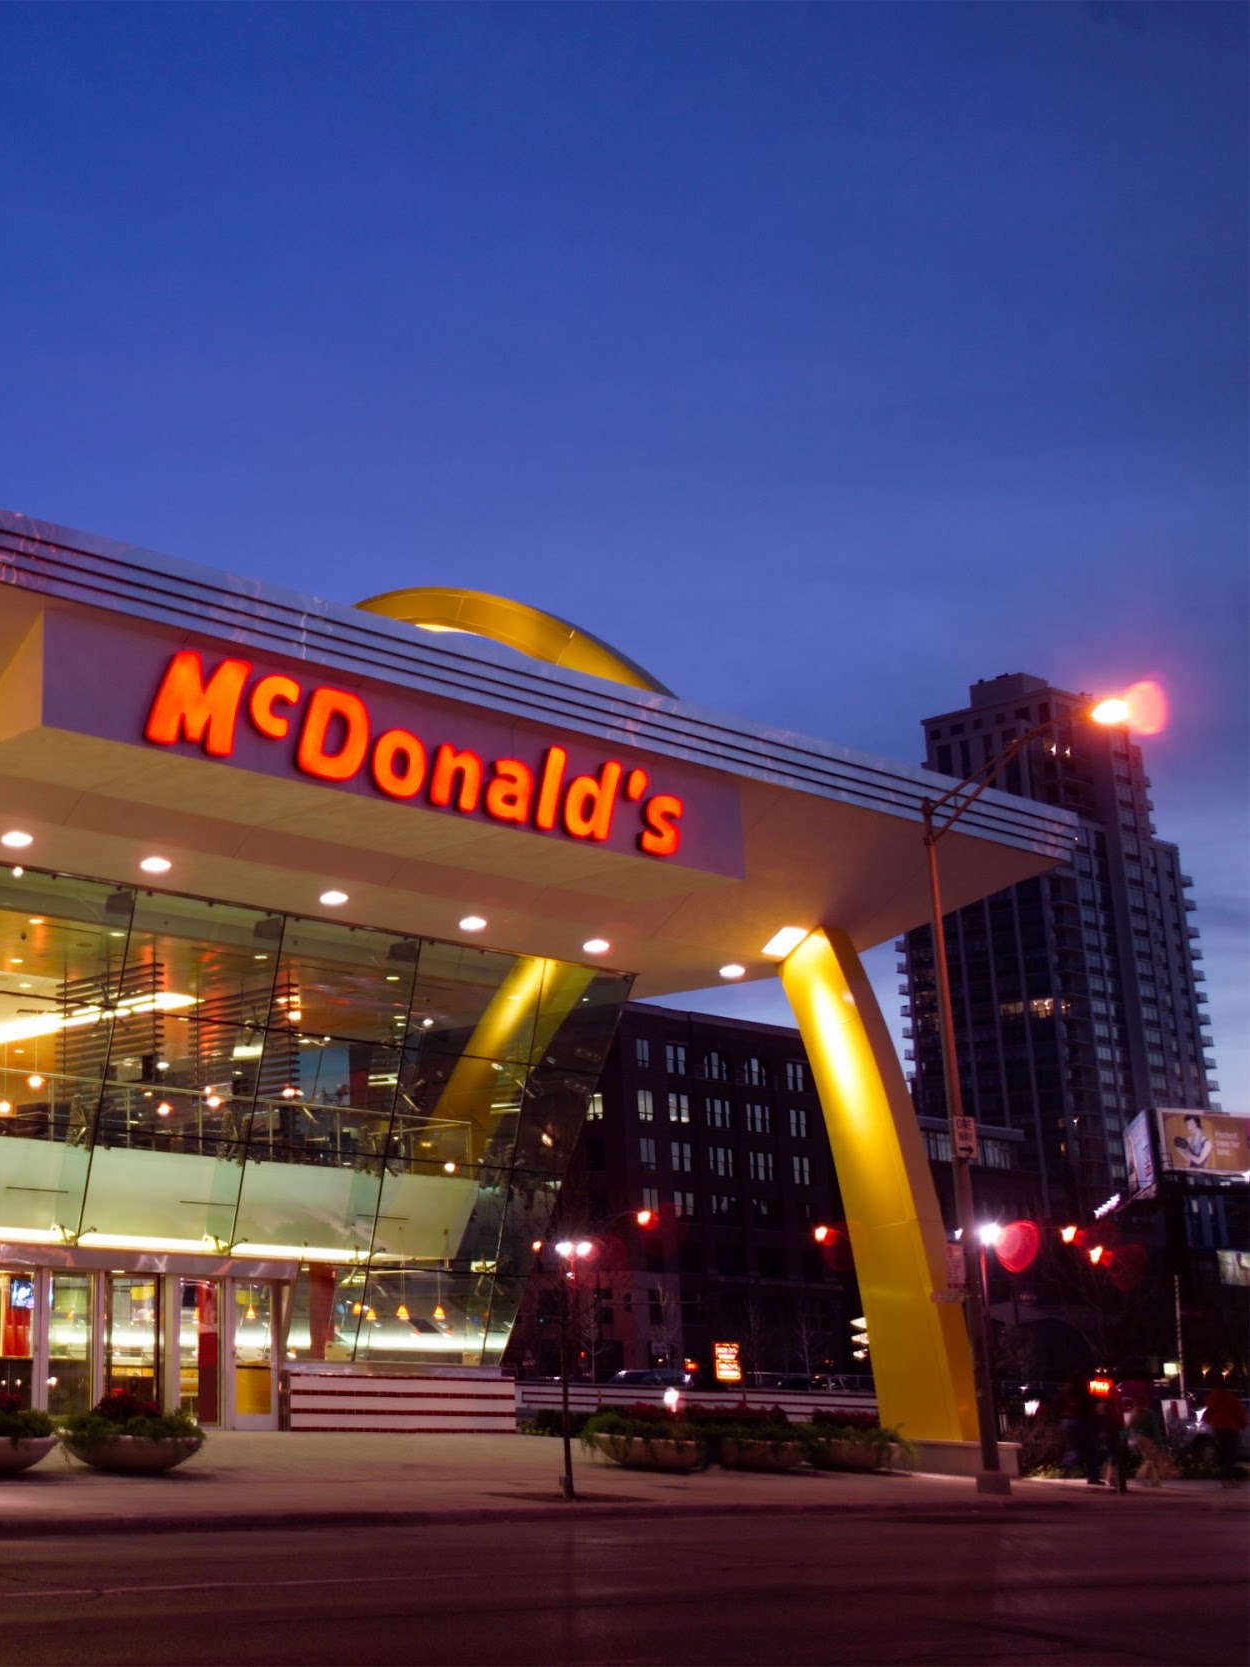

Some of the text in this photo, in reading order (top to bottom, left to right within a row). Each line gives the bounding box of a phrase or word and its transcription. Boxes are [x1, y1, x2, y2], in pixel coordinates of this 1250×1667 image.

[145, 650, 683, 857] McDonald's
[956, 1118, 972, 1130] ONE
[957, 1131, 973, 1141] WAY
